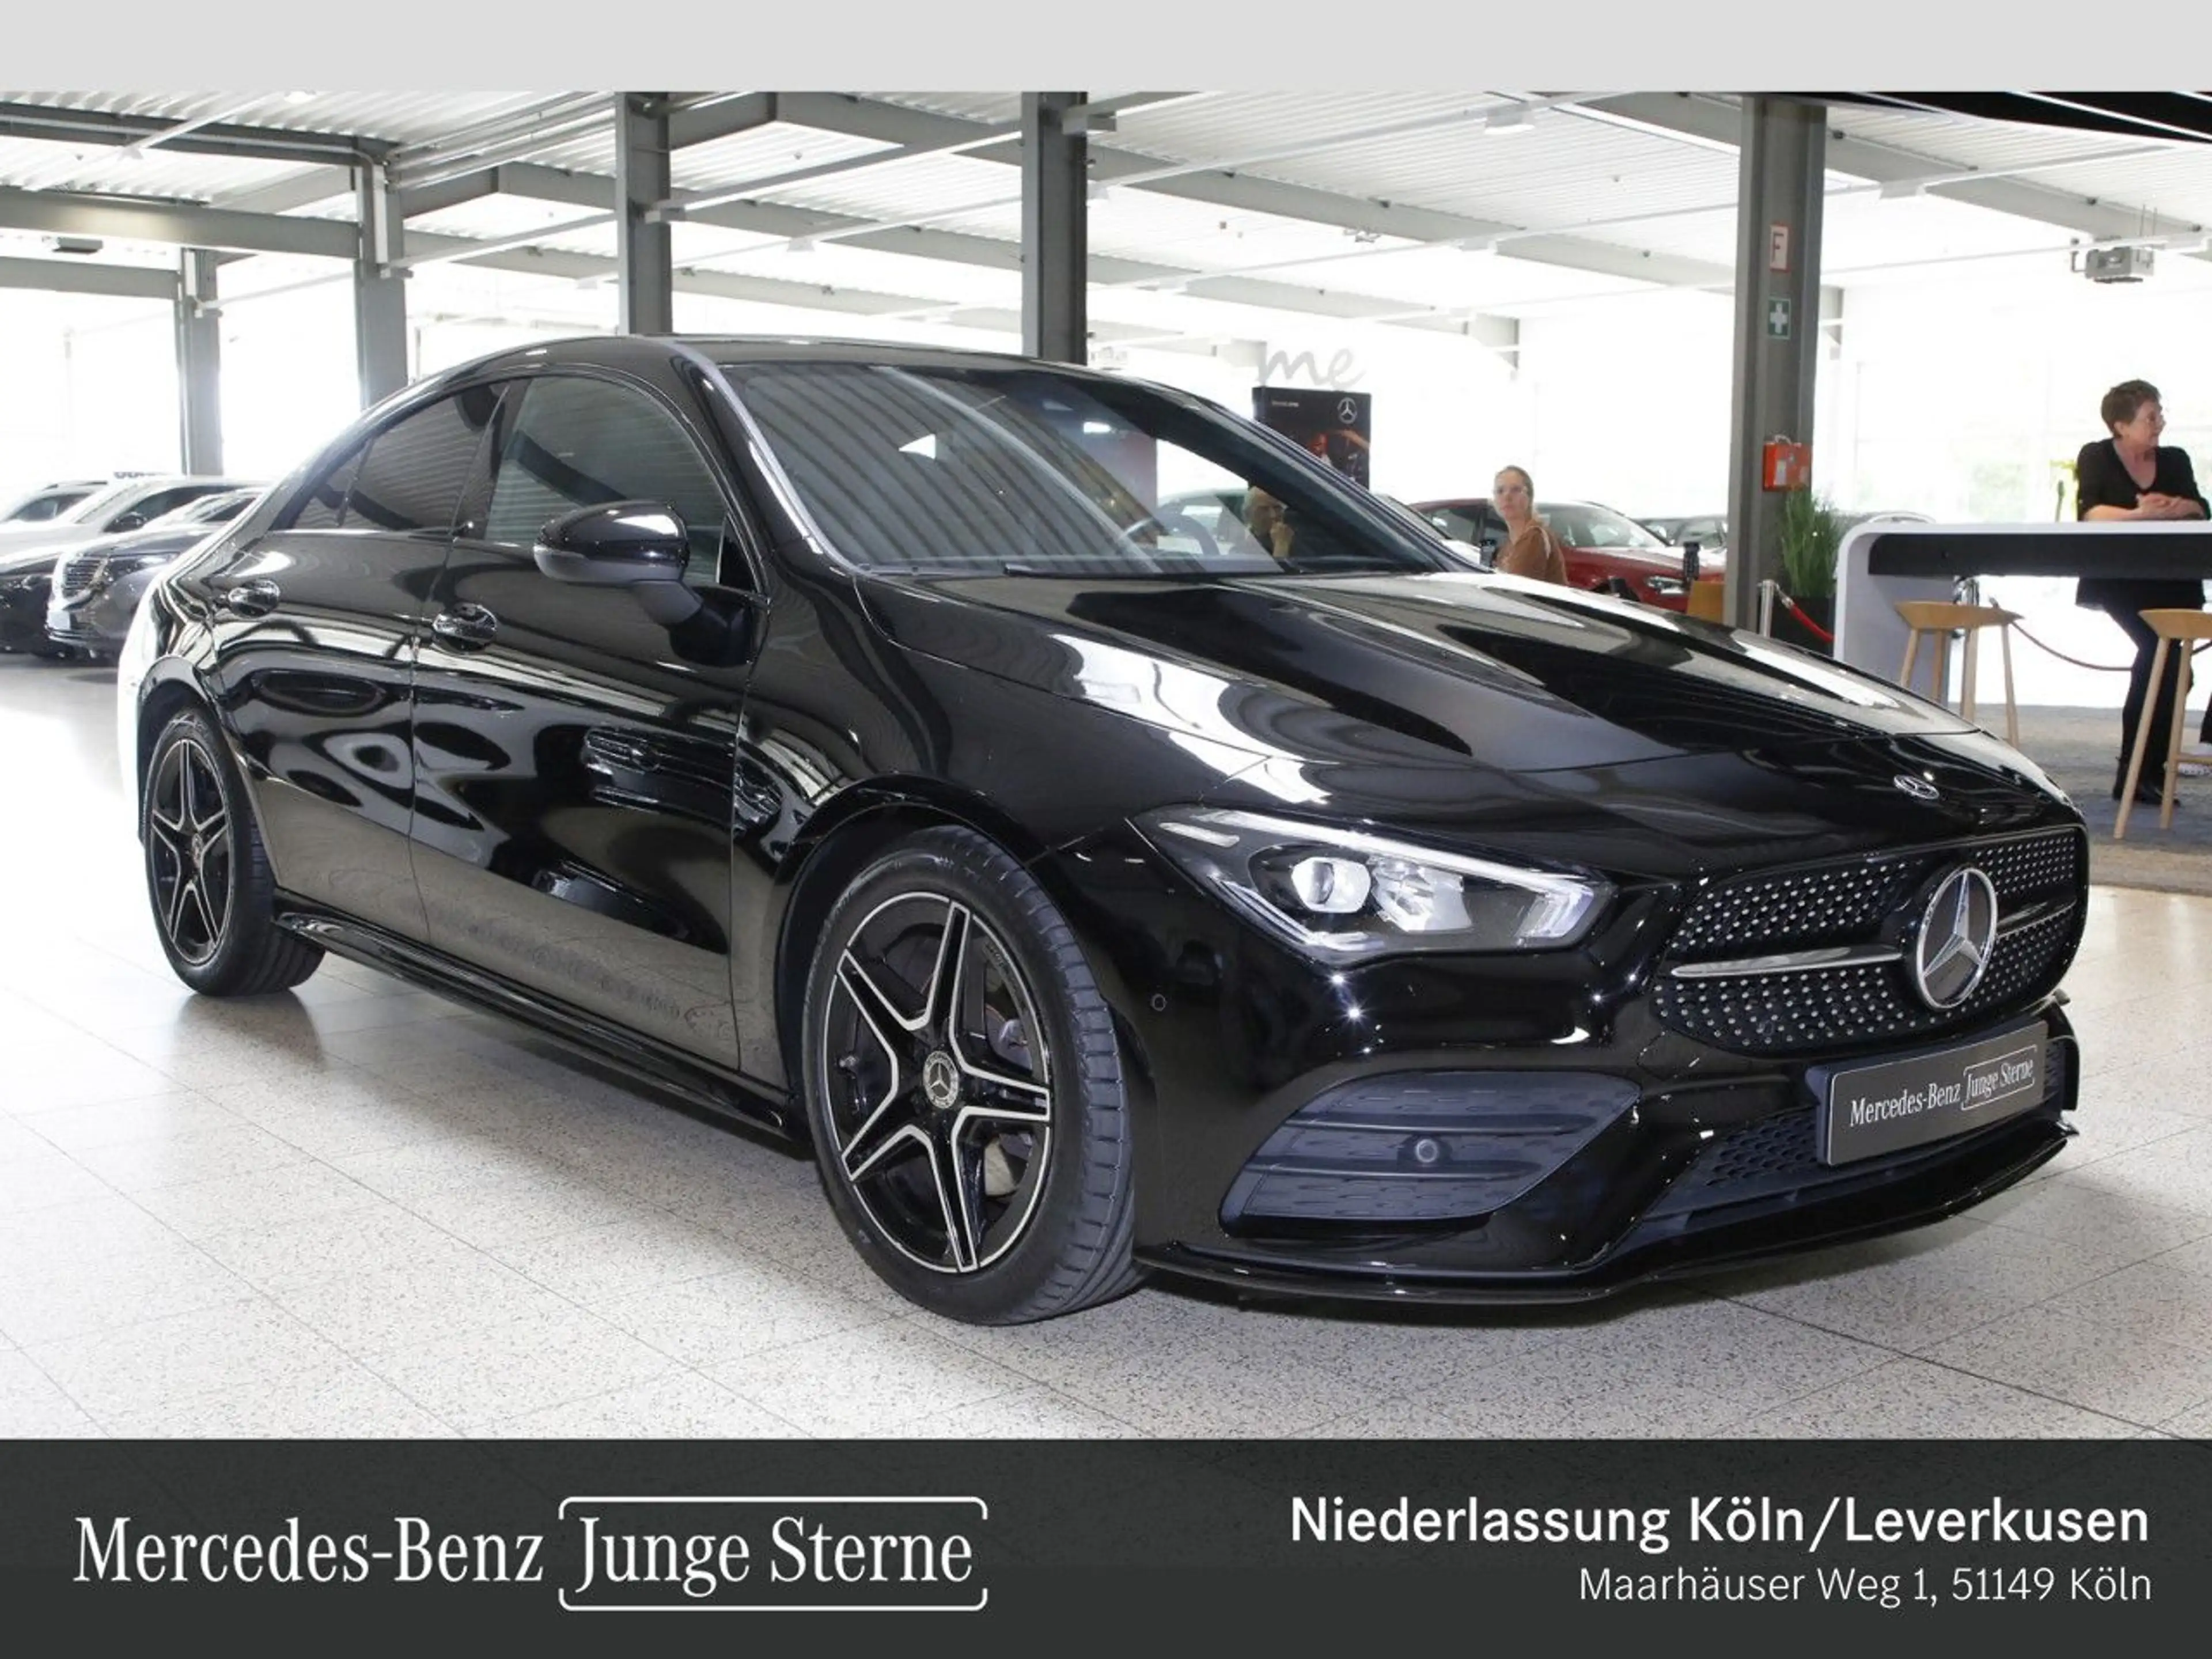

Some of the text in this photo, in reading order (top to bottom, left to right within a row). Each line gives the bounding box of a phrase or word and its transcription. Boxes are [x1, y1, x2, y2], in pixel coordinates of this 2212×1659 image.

[1258, 348, 1368, 390] me
[1850, 1058, 2034, 1127] Mercedes-Benz Junge Sterne
